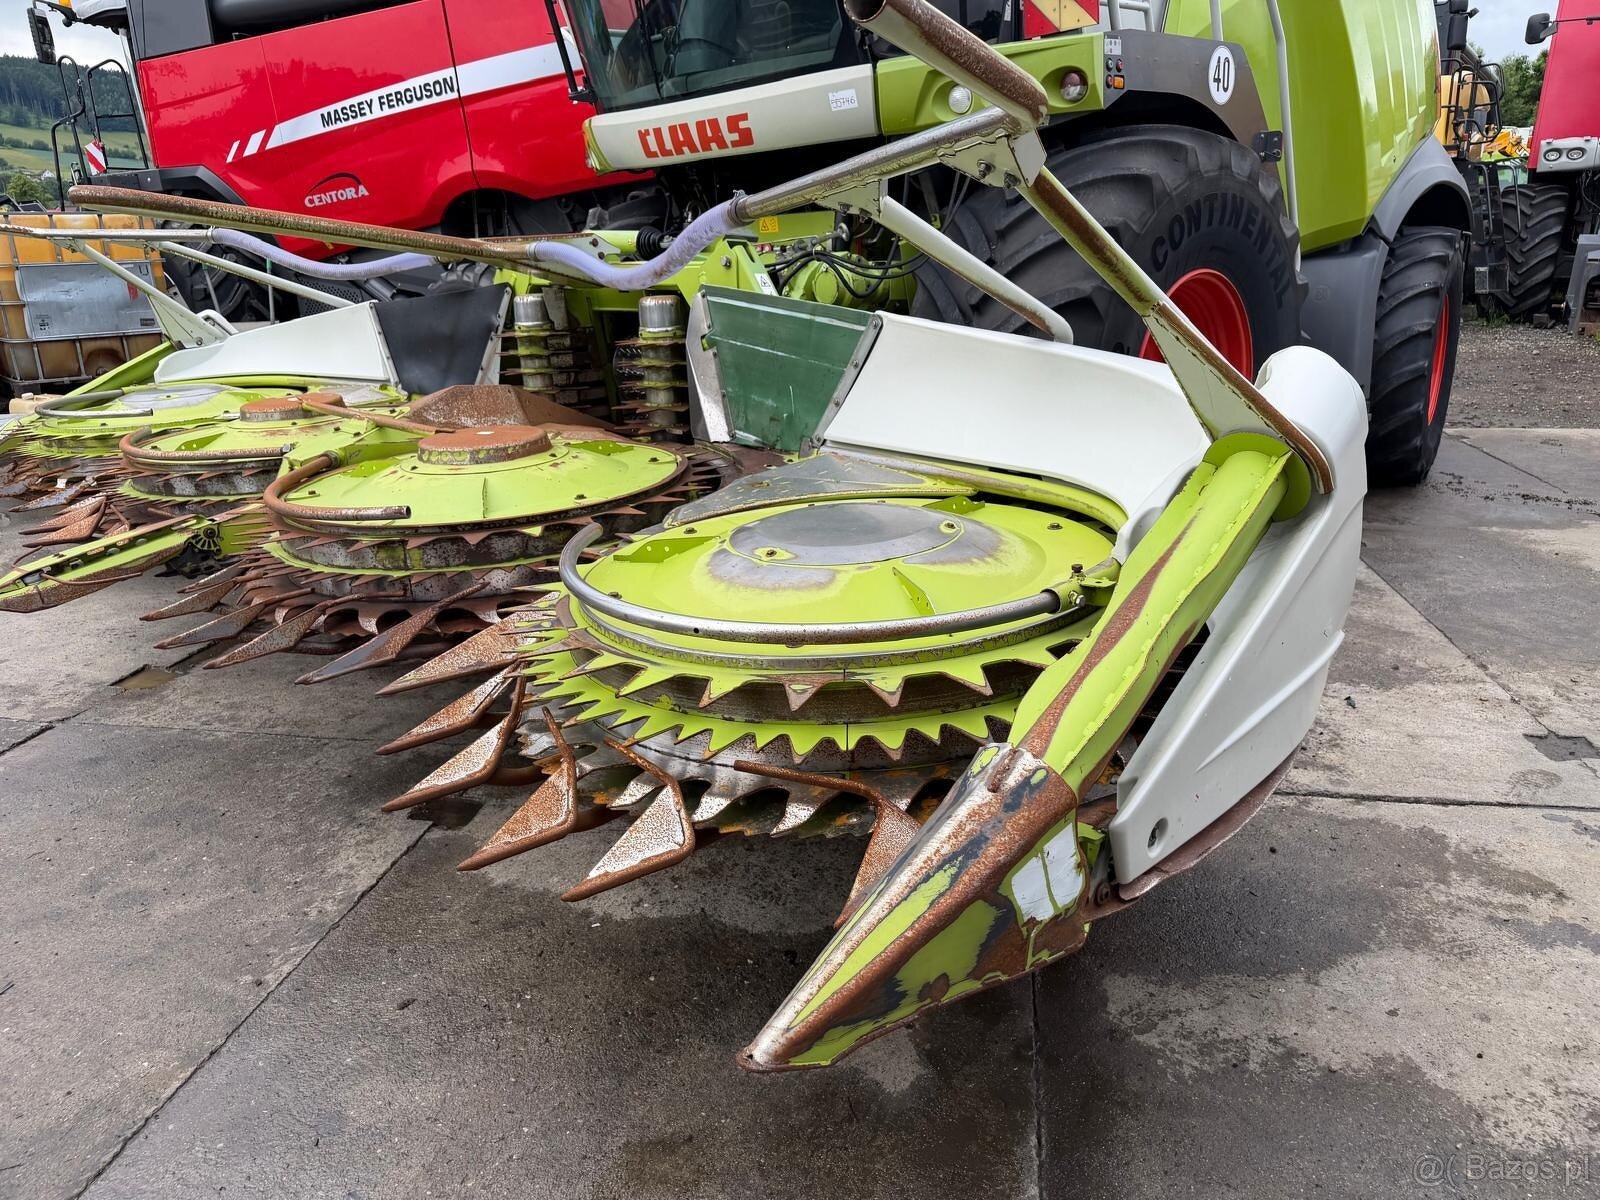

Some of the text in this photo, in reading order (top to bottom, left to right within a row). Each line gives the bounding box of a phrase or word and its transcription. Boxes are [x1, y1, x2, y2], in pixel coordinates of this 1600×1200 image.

[1213, 55, 1230, 93] 40
[320, 76, 455, 129] MASSEY FERGUSON
[638, 112, 755, 159] CLAAS
[304, 184, 370, 208] CENTORA
[1151, 192, 1290, 310] CONTINENTAL
